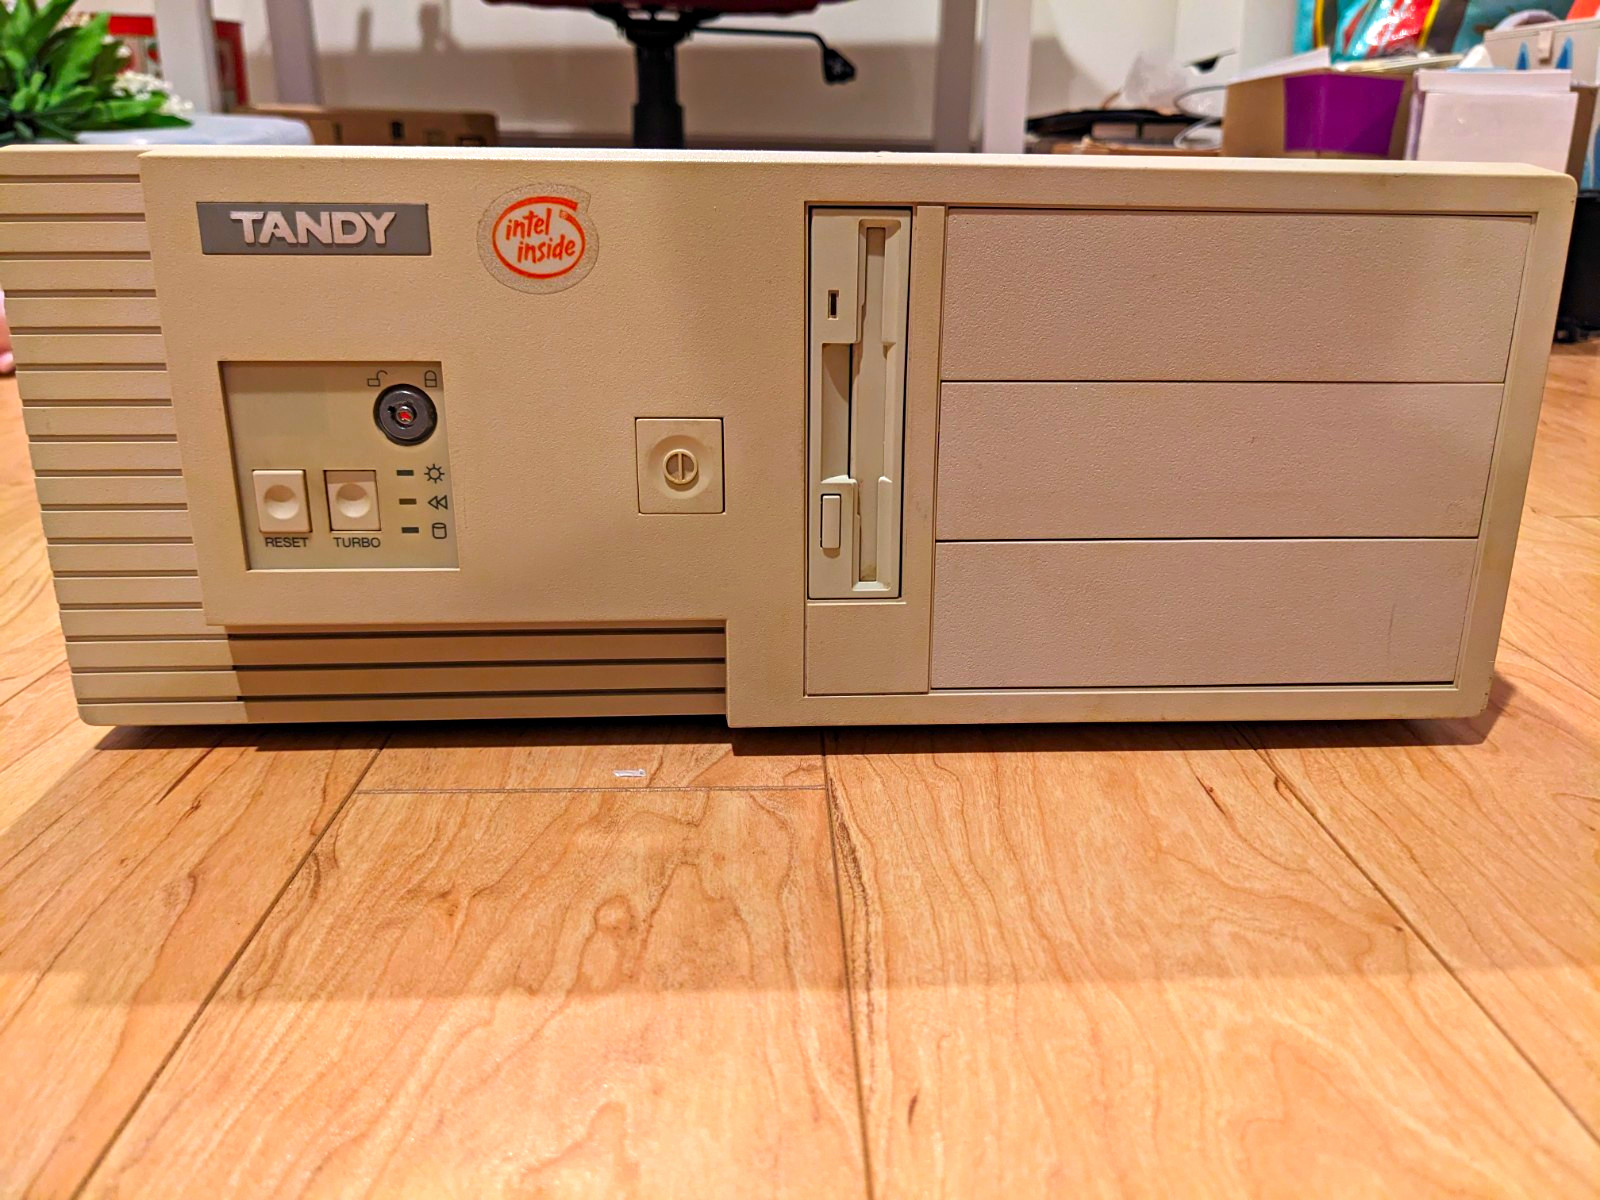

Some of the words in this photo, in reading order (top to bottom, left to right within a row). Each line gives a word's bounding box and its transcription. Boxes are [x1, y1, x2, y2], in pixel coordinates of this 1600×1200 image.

[229, 210, 397, 245] TANDY
[505, 207, 552, 241] intel
[517, 234, 576, 264] inside
[264, 536, 309, 548] RESET
[332, 536, 382, 549] TURBO
